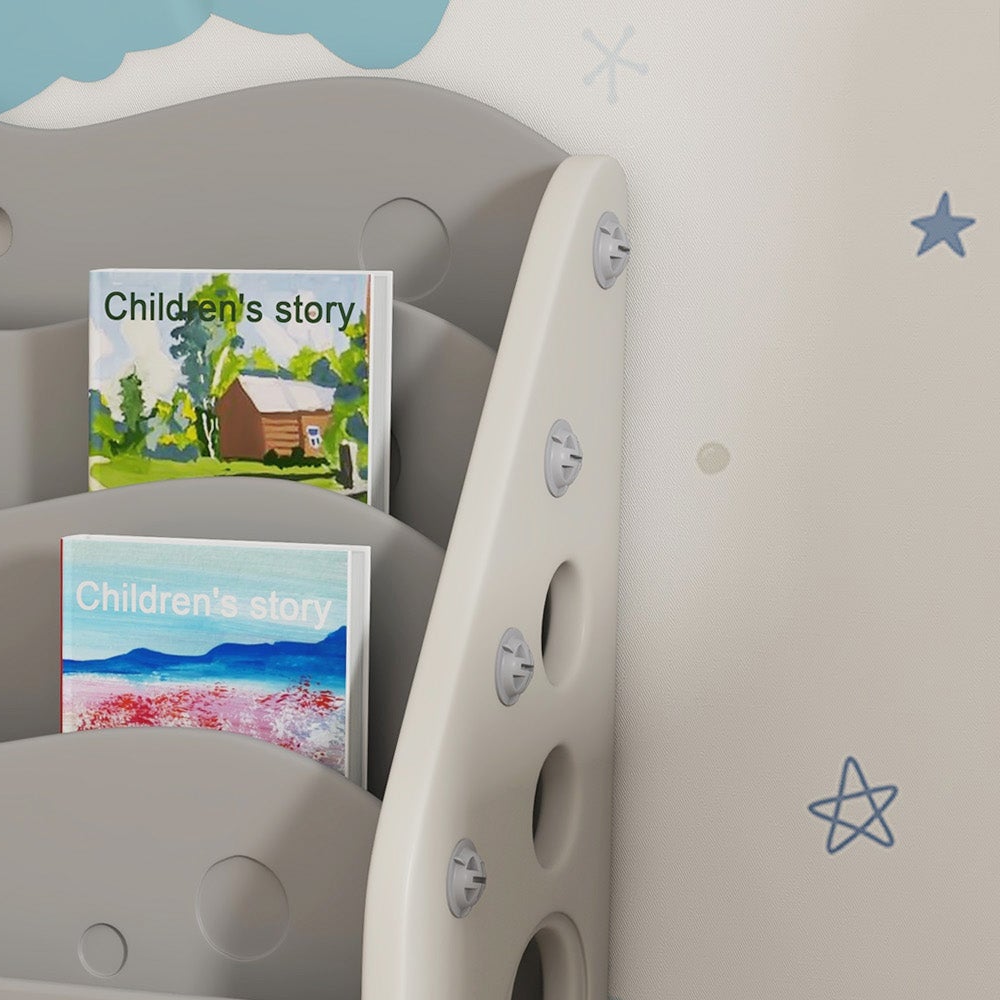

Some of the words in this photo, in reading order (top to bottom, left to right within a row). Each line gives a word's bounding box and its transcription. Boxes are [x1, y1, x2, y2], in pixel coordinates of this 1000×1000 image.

[104, 291, 263, 323] Children's
[275, 294, 356, 332] story
[76, 581, 239, 618] Children's
[251, 590, 333, 630] story
